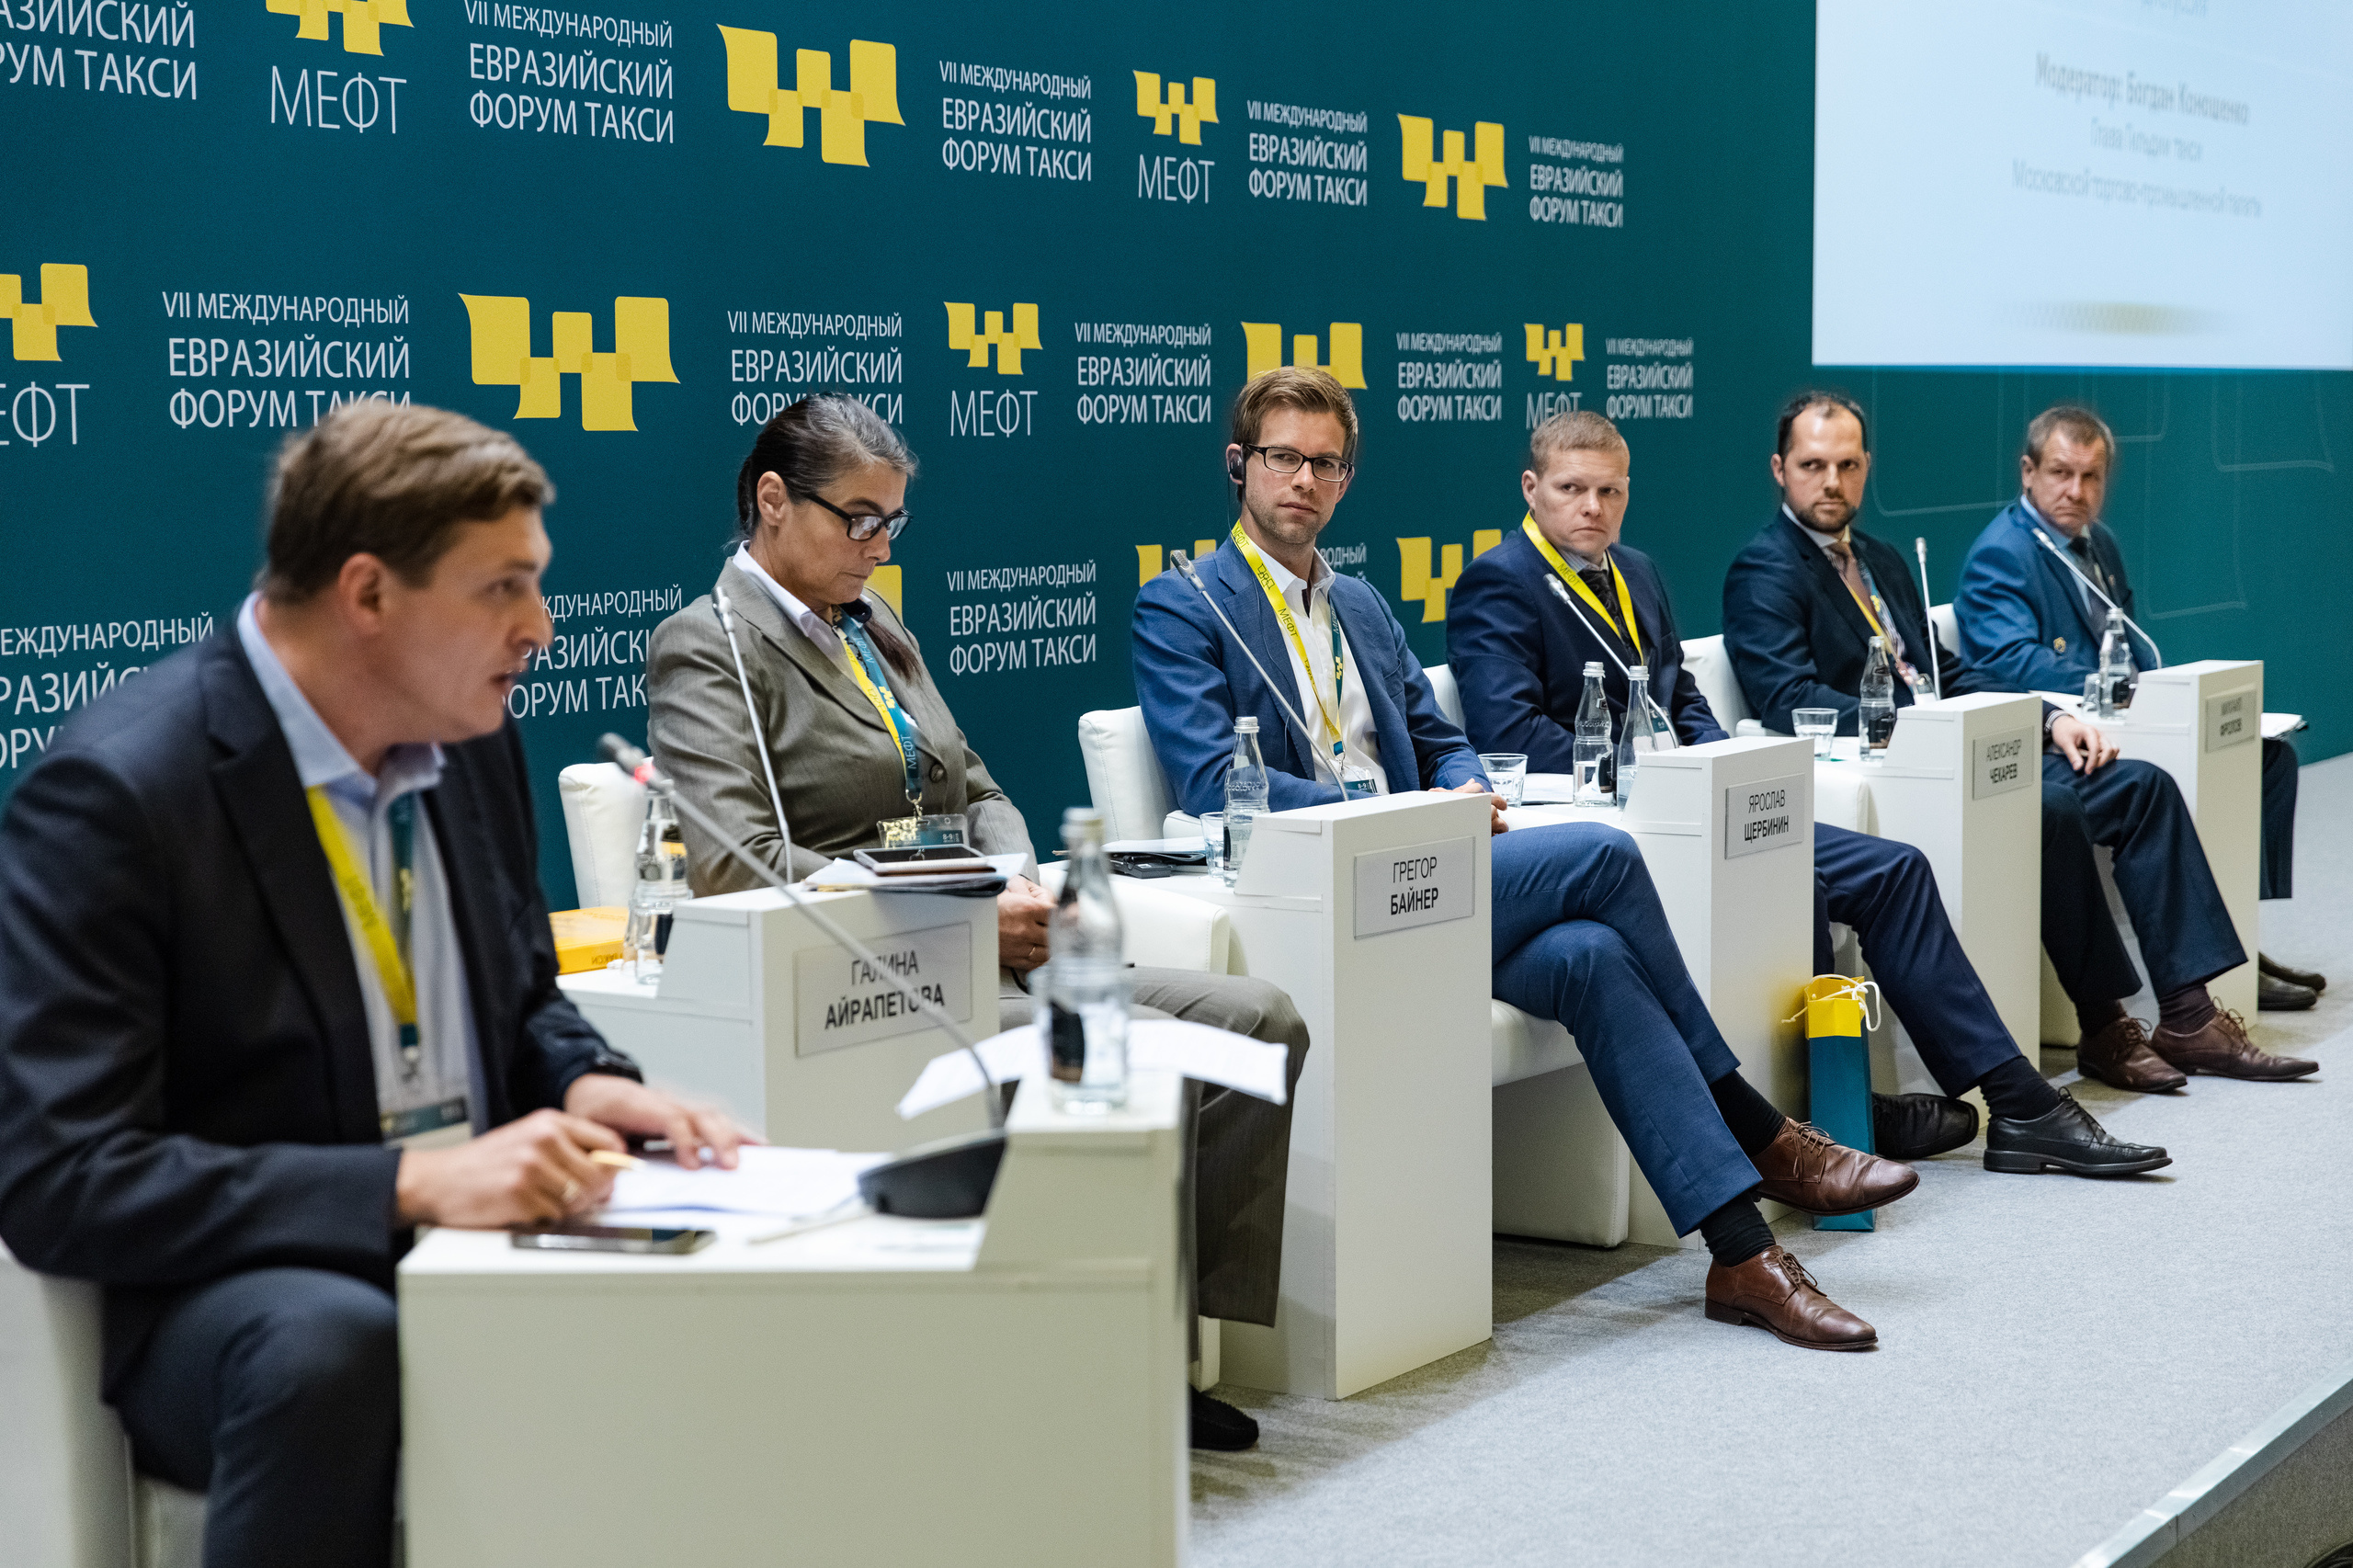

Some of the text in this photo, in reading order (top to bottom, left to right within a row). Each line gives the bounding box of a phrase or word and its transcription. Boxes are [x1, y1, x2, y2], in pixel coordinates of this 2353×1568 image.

[464, 0, 672, 48] VII МЕЖДУНАРОДНЫЙ
[0, 42, 196, 100] УМ ТАКСИ
[471, 43, 672, 99] ЕВРАЗИЙСКИЙ
[939, 61, 1091, 99] VII МЕЖДУНАРОДНЫЙ
[271, 66, 406, 133] МЕФТ
[470, 90, 673, 143] ФОРУМ ТАКСИ
[1247, 100, 1367, 133] VII МЕЖДУНАРОДНЫЙ
[943, 97, 1090, 143] ЕВРАЗИЙСКИЙ
[943, 137, 1091, 181] ФОРУМ ТАКСИ
[1250, 133, 1367, 172] ЕВРАЗИЙСКИЙ
[1529, 136, 1623, 163] VII МЕЖДУНАРОДНЫЙ
[1139, 154, 1214, 203] МЕФТ
[1249, 168, 1367, 206] ФОРУМ ТАКСИ
[1530, 165, 1623, 197] ЕВРАЗИЙСКИЙ
[1529, 196, 1623, 227] ФОРУМ ТАКСИ
[163, 291, 408, 328] VII МЕЖДУНАРОДНЫЙ
[728, 311, 902, 340] VII МЕЖДУНАРОДНЫЙ
[1075, 323, 1211, 347] VII МЕЖДУНАРОДНЫЙ
[1396, 333, 1502, 354] VII МЕЖДУНАРОДНЫЙ
[169, 334, 409, 378] ЕВРАЗИЙСКИЙ
[732, 346, 902, 383] ЕВРАЗИЙСКИЙ
[1078, 353, 1211, 386] ЕВРАЗИЙСКИЙ
[1398, 359, 1501, 389] ЕВРАЗИЙСКИЙ
[170, 388, 301, 428] ФОРУМ
[950, 389, 1038, 437] МЕФТ
[1077, 393, 1211, 424] ФОРУМ ТАКСИ
[1398, 395, 1501, 422] ФОРУМ ТАКСИ
[947, 560, 1096, 592] VII МЕЖДУНАРОДНЫЙ
[950, 591, 1096, 636] ЕВРАЗИЙСКИЙ
[1279, 608, 1299, 638] МЕФТ
[950, 634, 1096, 676] ФОРУМ ТАКСИ
[503, 678, 588, 719] ОРУМ
[900, 733, 917, 769] МЕФТ
[1748, 790, 1786, 813] ЯРОСЛАВ
[1744, 814, 1790, 844] ЩЕРБИНИН
[1392, 856, 1438, 883] ГРЕГОР
[1391, 886, 1439, 915] БАЙНЕР
